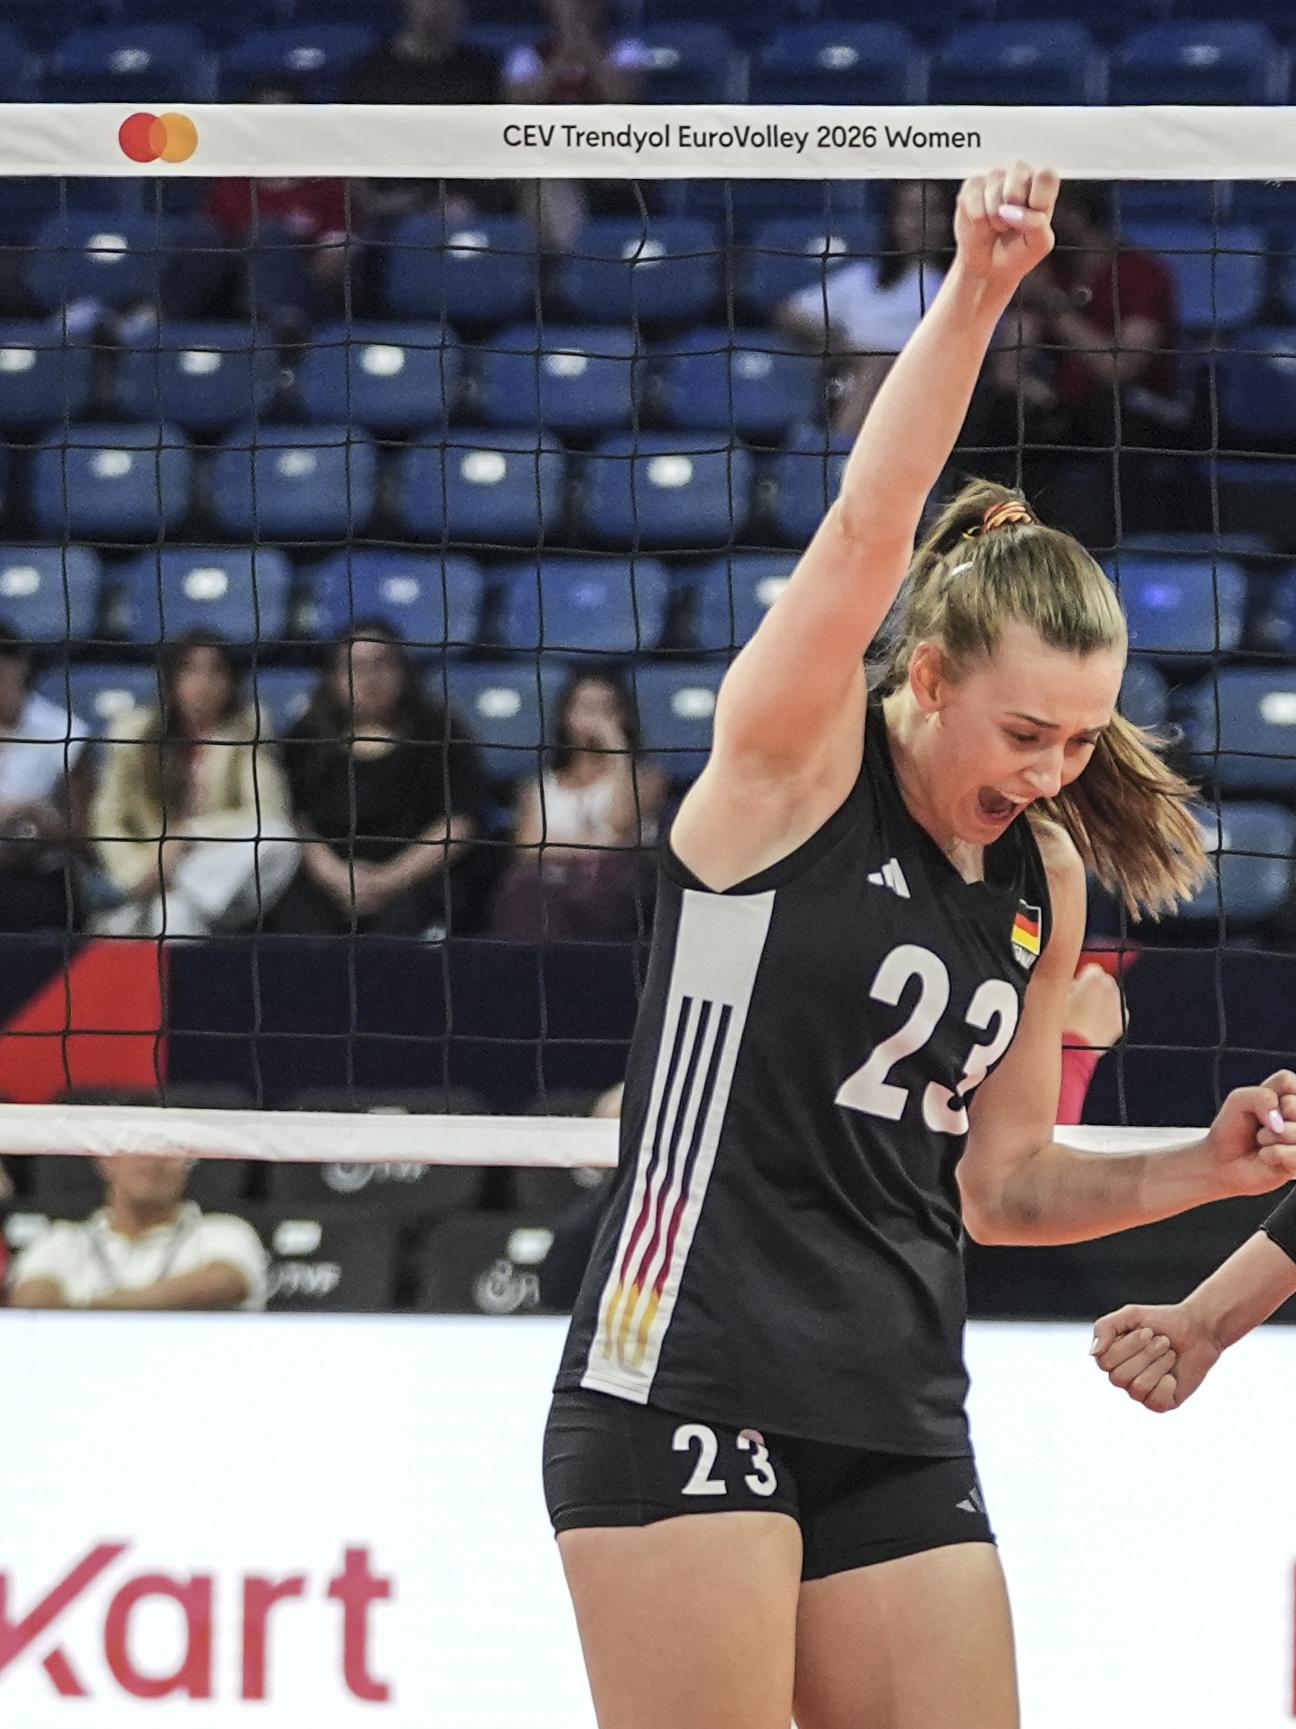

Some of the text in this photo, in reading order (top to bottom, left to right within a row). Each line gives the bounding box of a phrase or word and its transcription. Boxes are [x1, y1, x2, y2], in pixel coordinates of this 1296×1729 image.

[503, 123, 981, 153] CEV Trendyol EuroVolley 2026 Women
[834, 943, 1018, 1135] 23
[672, 1423, 778, 1497] 23
